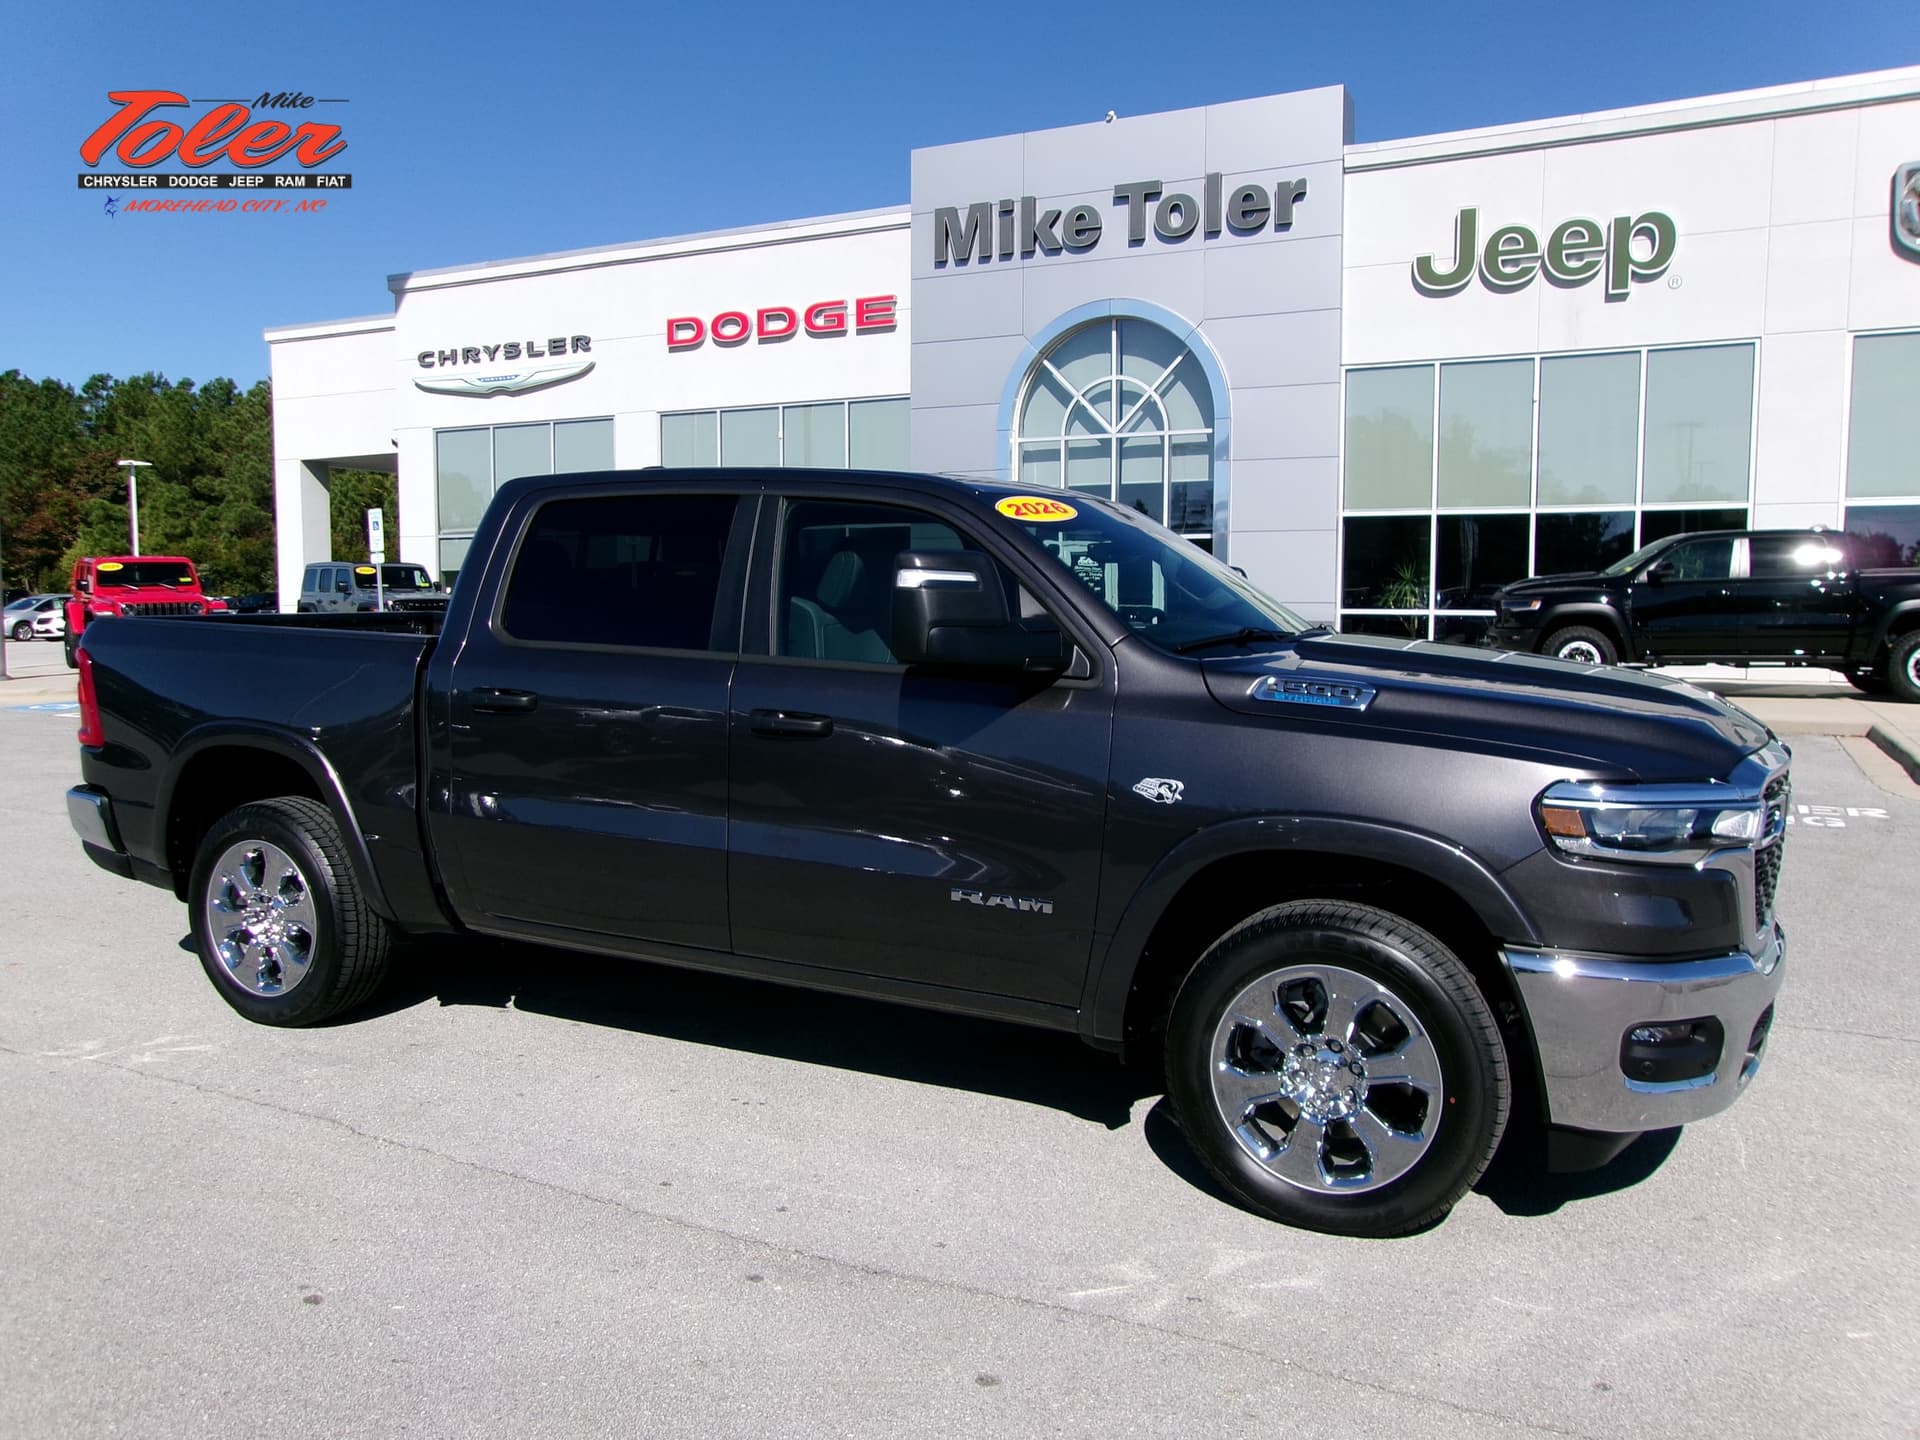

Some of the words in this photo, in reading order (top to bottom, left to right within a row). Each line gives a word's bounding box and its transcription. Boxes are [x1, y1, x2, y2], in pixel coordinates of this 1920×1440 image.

[934, 196, 1103, 268] Mike
[1113, 172, 1307, 248] Toler
[1411, 206, 1679, 302] Jeep
[666, 294, 897, 353] DODGE
[417, 335, 592, 368] CHRYSLER
[1007, 502, 1068, 516] 2026
[950, 887, 1056, 915] RAM
